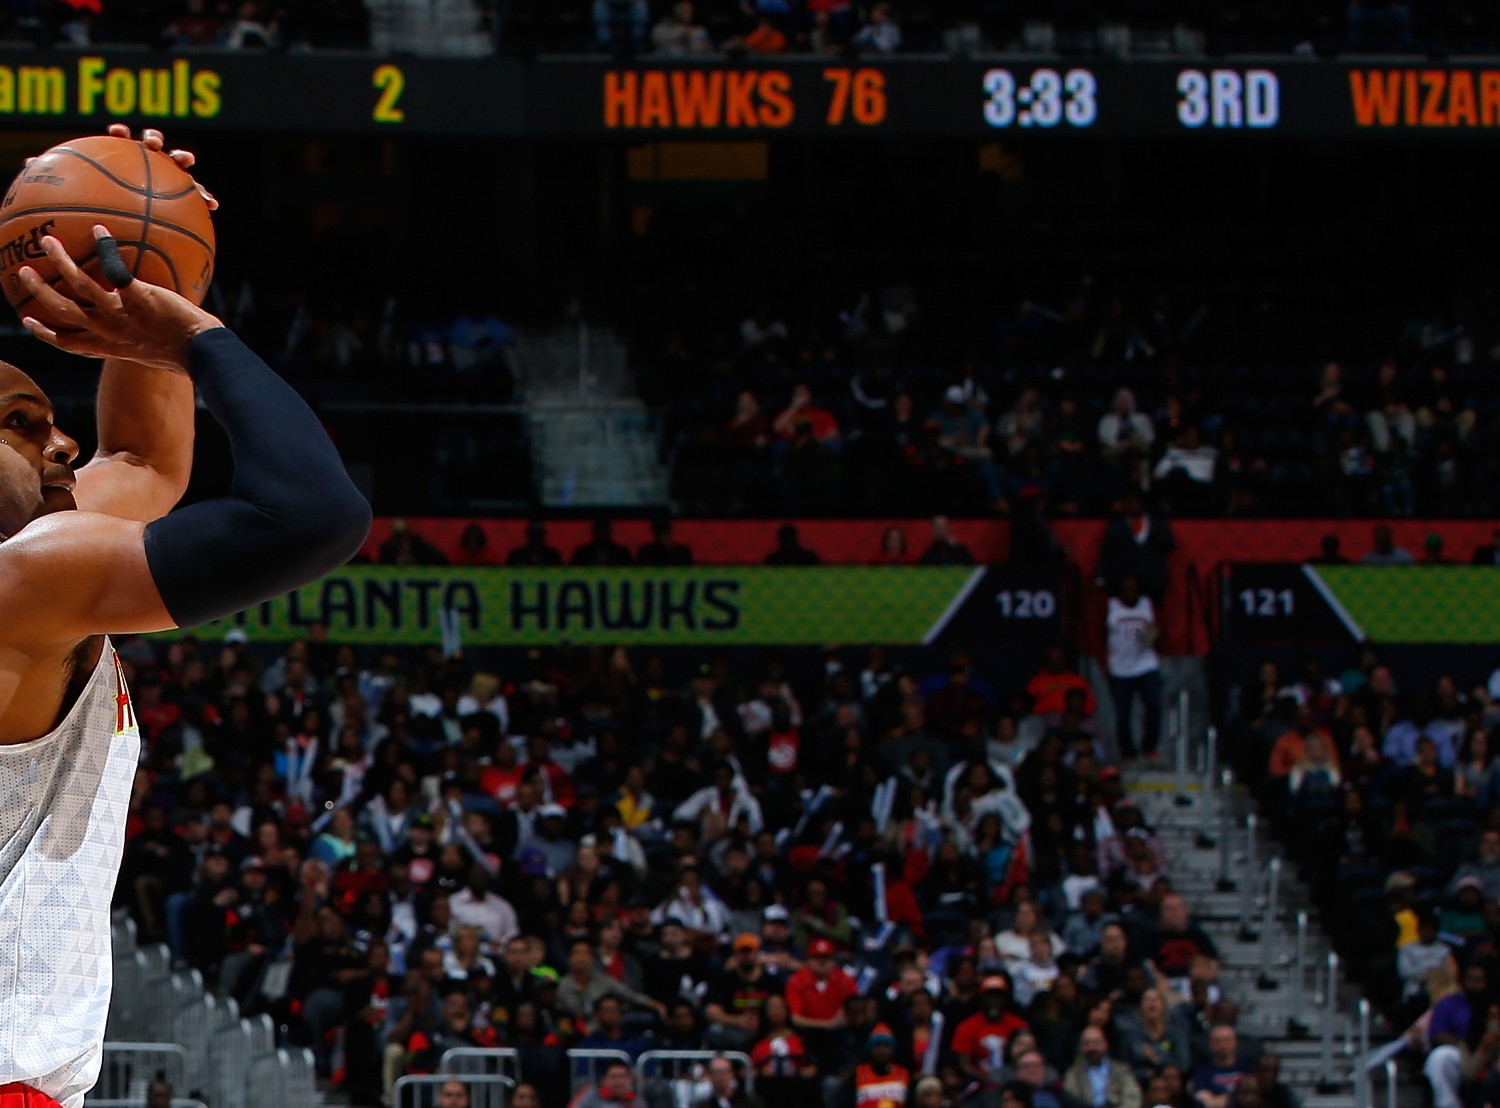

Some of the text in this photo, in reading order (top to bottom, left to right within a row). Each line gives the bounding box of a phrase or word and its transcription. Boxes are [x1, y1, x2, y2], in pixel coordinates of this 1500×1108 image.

[78, 57, 222, 120] Fouls
[373, 64, 405, 124] 2
[603, 69, 794, 129] HAWKS
[823, 67, 888, 126] 76
[982, 68, 1098, 129] 3:33
[1177, 69, 1280, 129] 3RD
[211, 577, 741, 631] LANTA HAWKS
[996, 588, 1056, 618] 120
[1239, 588, 1295, 617] 121
